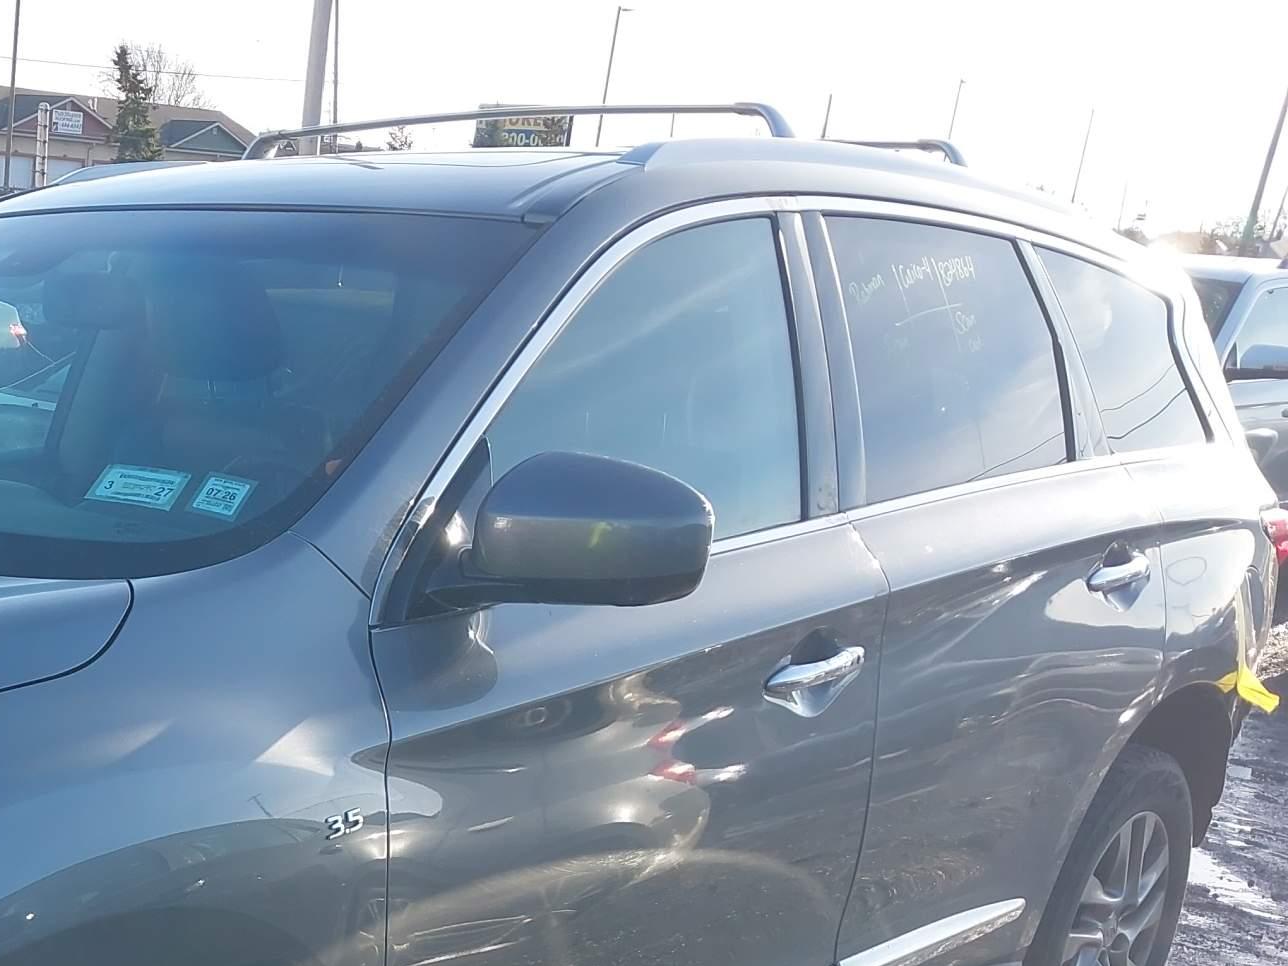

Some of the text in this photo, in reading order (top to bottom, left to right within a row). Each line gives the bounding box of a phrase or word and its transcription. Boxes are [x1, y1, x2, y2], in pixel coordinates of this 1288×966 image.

[104, 480, 114, 490] 3
[154, 486, 174, 498] 27
[206, 487, 237, 501] 07 26
[324, 807, 364, 840] 3.5
